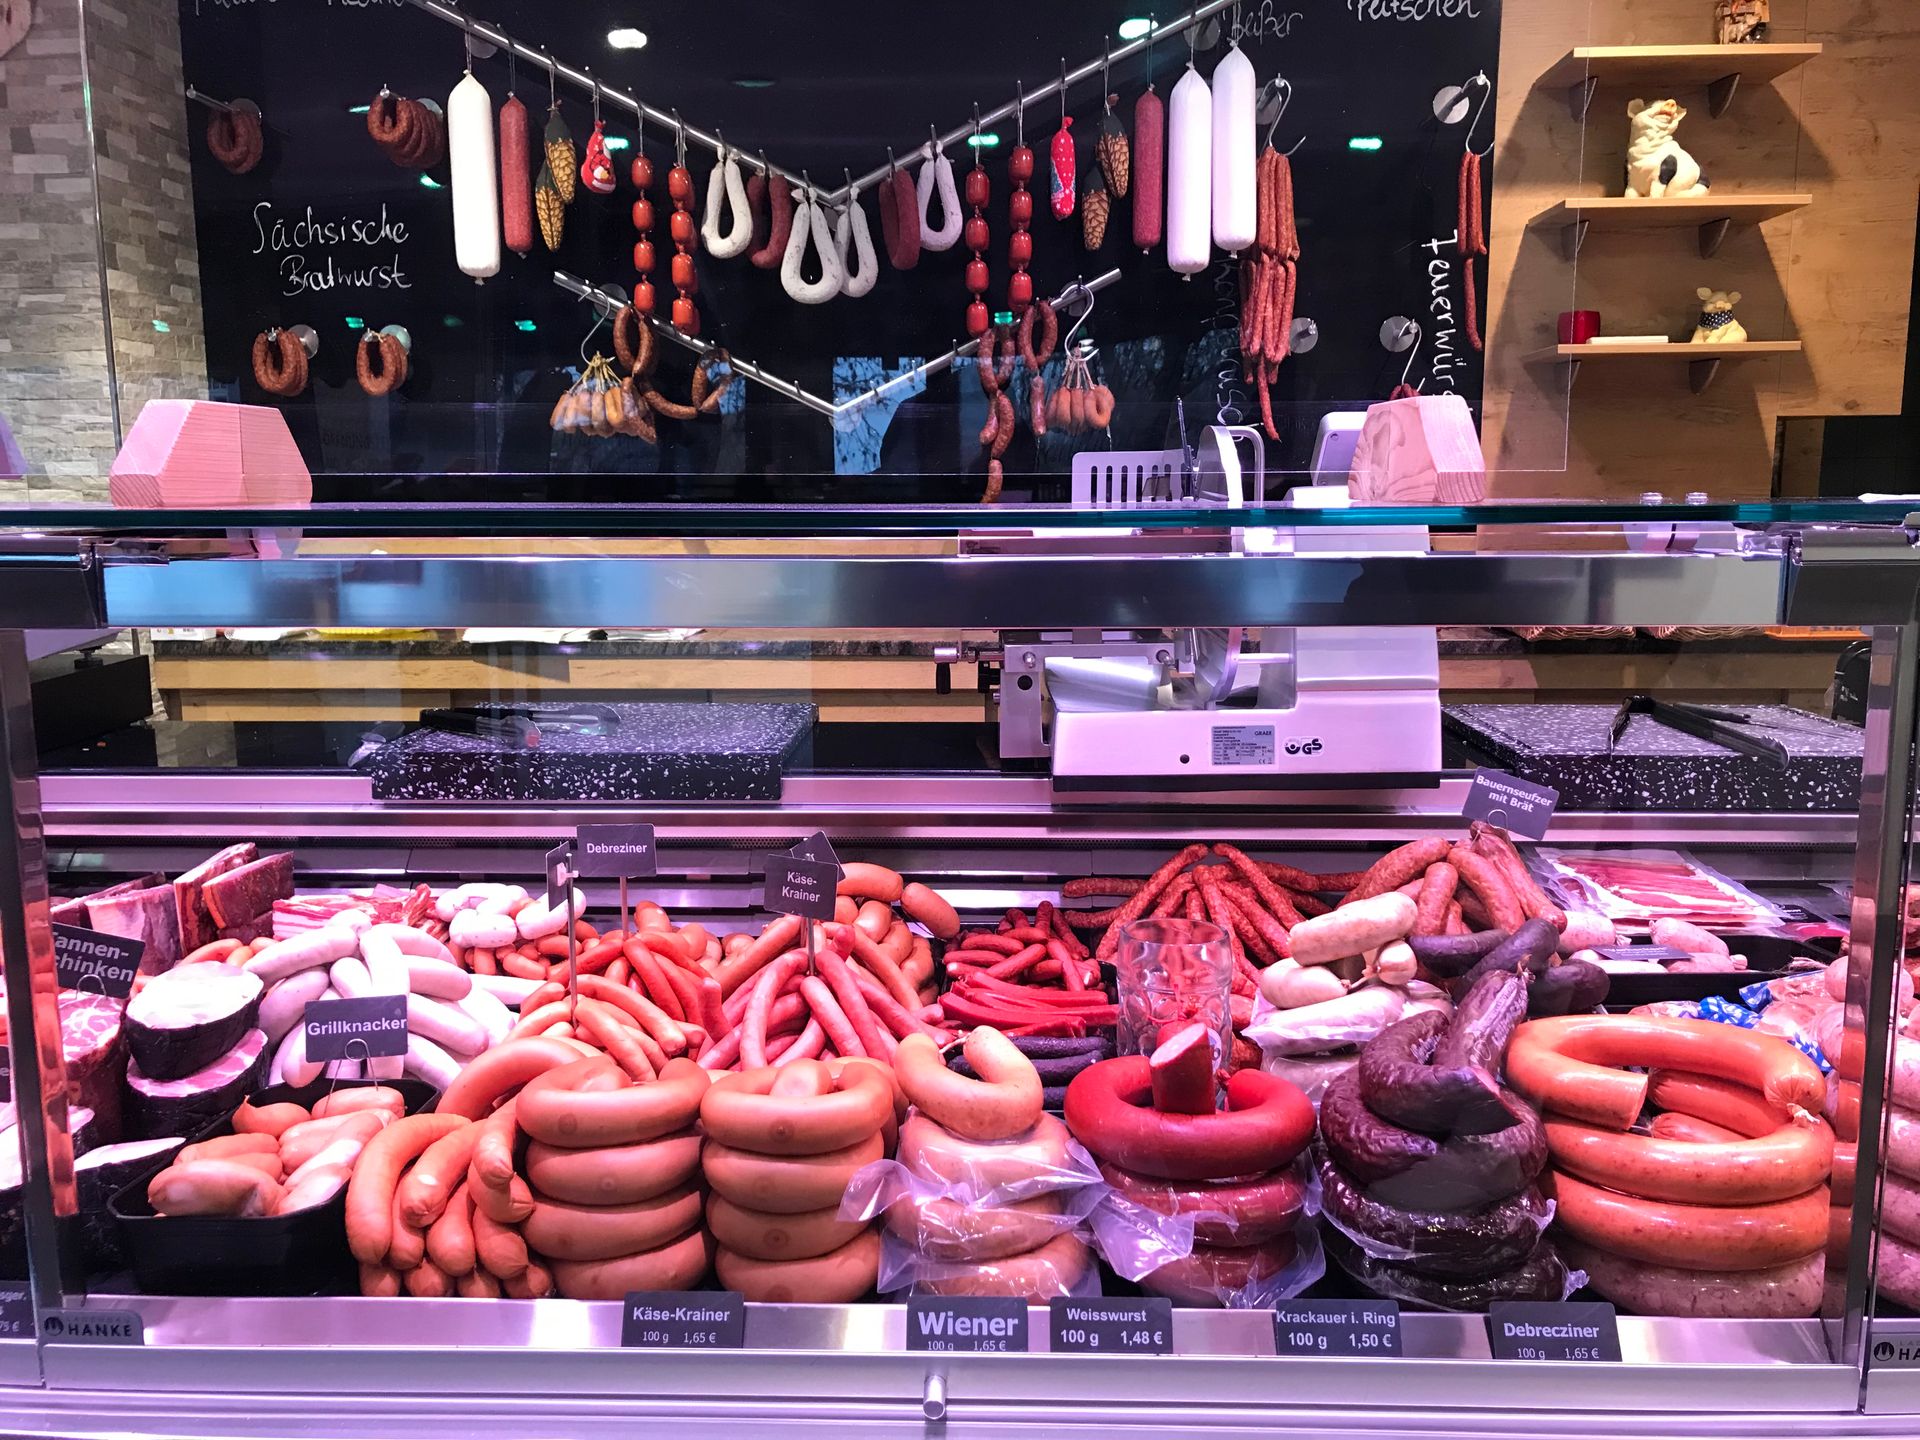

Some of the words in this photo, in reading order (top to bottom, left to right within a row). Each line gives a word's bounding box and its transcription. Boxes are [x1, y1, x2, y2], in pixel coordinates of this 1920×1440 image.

[252, 201, 409, 254] Sächsische
[280, 253, 412, 296] Bratwurst
[1421, 229, 1467, 396] Feuerwür
[1476, 775, 1552, 807] Bauernseufzer
[1488, 792, 1508, 804] mit
[1509, 797, 1534, 812] Brät
[586, 843, 648, 853] Debreziner
[787, 871, 817, 885] Käse-
[782, 886, 820, 902] Krainer
[307, 1018, 407, 1036] Grillknacker
[633, 1307, 730, 1321] Käse-Krainer
[1066, 1308, 1147, 1321] Weisswurst
[1276, 1311, 1347, 1324] Krackauer
[1350, 1312, 1359, 1324] i.
[1363, 1312, 1395, 1328] Ring
[68, 1323, 132, 1337] HANKE
[917, 1310, 1019, 1336] Wiener
[1503, 1322, 1600, 1338] Debrecziner
[642, 1331, 660, 1342] 100
[662, 1333, 669, 1344] g
[683, 1332, 706, 1344] 1,65
[708, 1332, 717, 1343] €
[1060, 1329, 1085, 1343] 100
[1090, 1333, 1099, 1346] g
[1120, 1331, 1150, 1346] 1,48
[1153, 1331, 1163, 1344] €
[1288, 1332, 1313, 1346] 100
[1318, 1336, 1328, 1349] g
[1349, 1333, 1379, 1349] 1,50
[1382, 1334, 1392, 1347] €
[927, 1340, 945, 1351] 100
[973, 1340, 996, 1352] 1,65
[998, 1340, 1007, 1351] €
[1517, 1348, 1535, 1358] 100
[1538, 1350, 1546, 1360] g
[1564, 1347, 1589, 1360] 1,65
[1590, 1348, 1600, 1359] €
